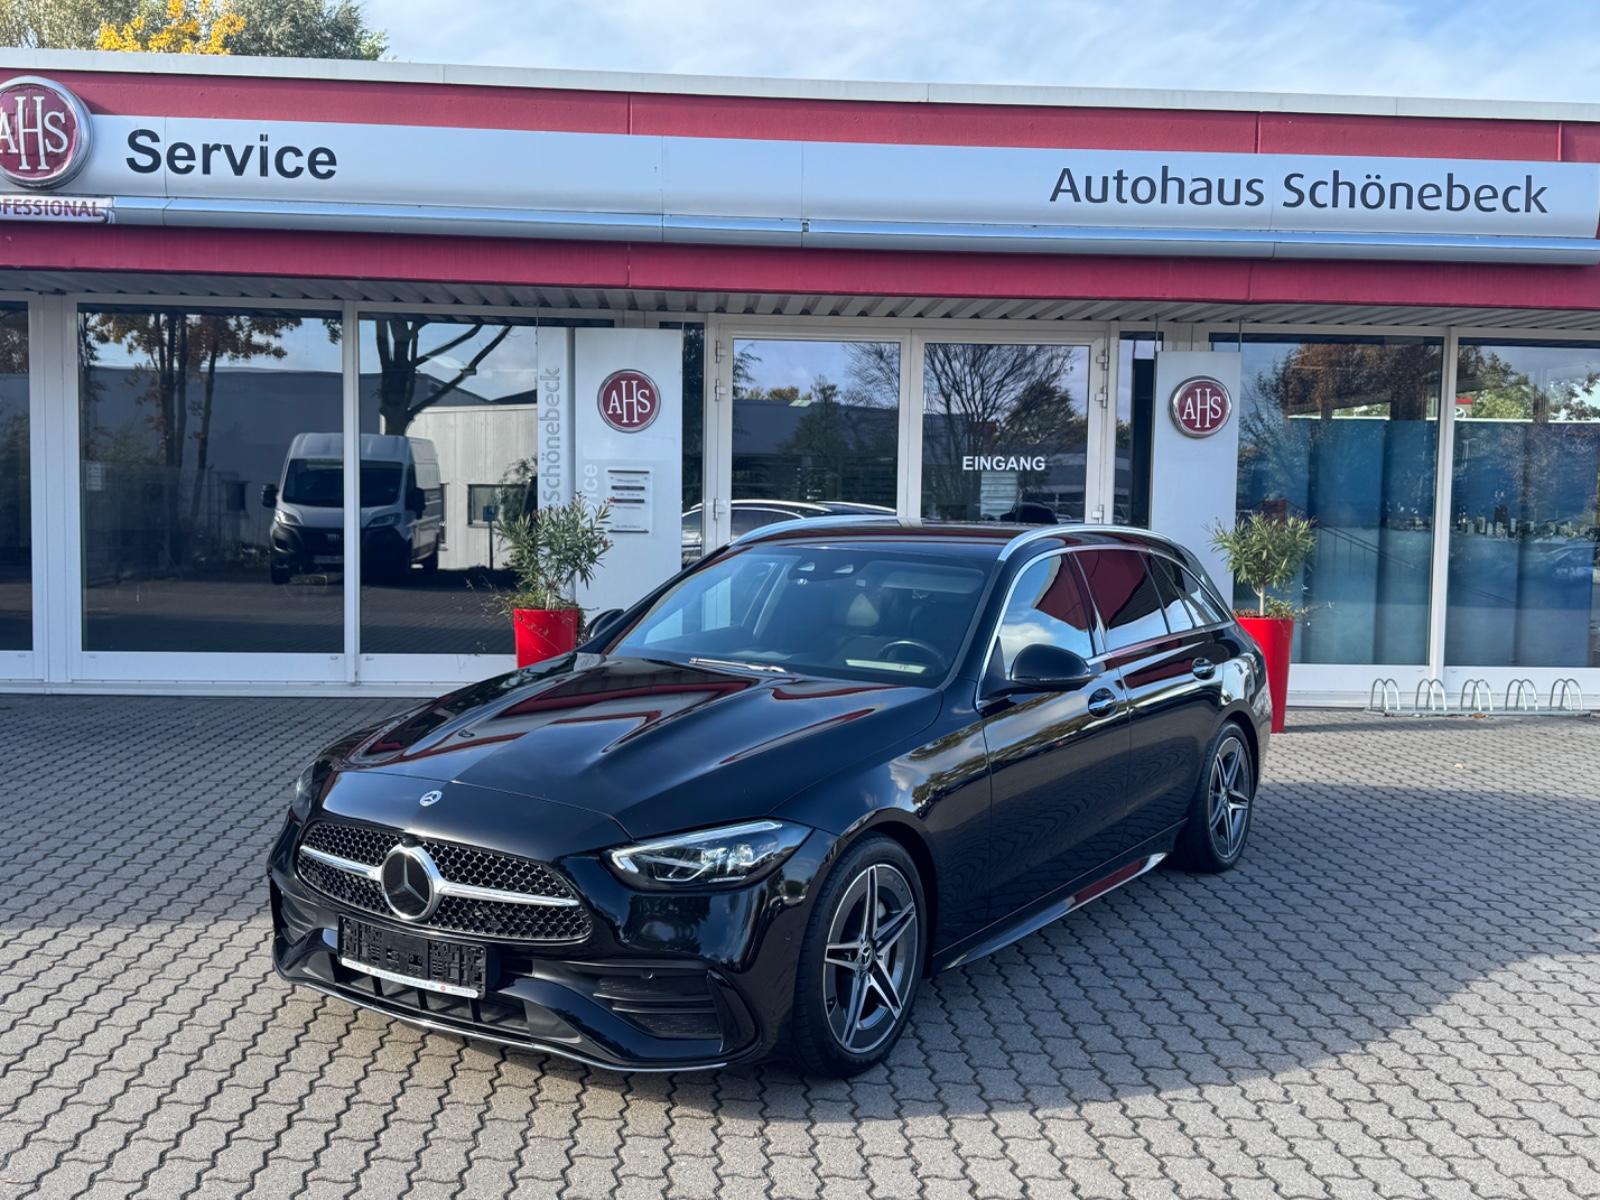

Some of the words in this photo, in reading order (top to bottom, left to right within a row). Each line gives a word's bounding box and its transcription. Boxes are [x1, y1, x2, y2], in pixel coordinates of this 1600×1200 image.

[0, 96, 68, 170] AHS
[126, 128, 338, 180] Service
[0, 198, 102, 217] FESSIONAL
[1049, 165, 1265, 207] Autohaus
[1282, 169, 1549, 214] Schönebeck
[607, 380, 651, 424] AHS
[1181, 388, 1222, 428] AHS
[540, 367, 561, 502] Schönebeck
[962, 455, 1046, 471] EINGANG
